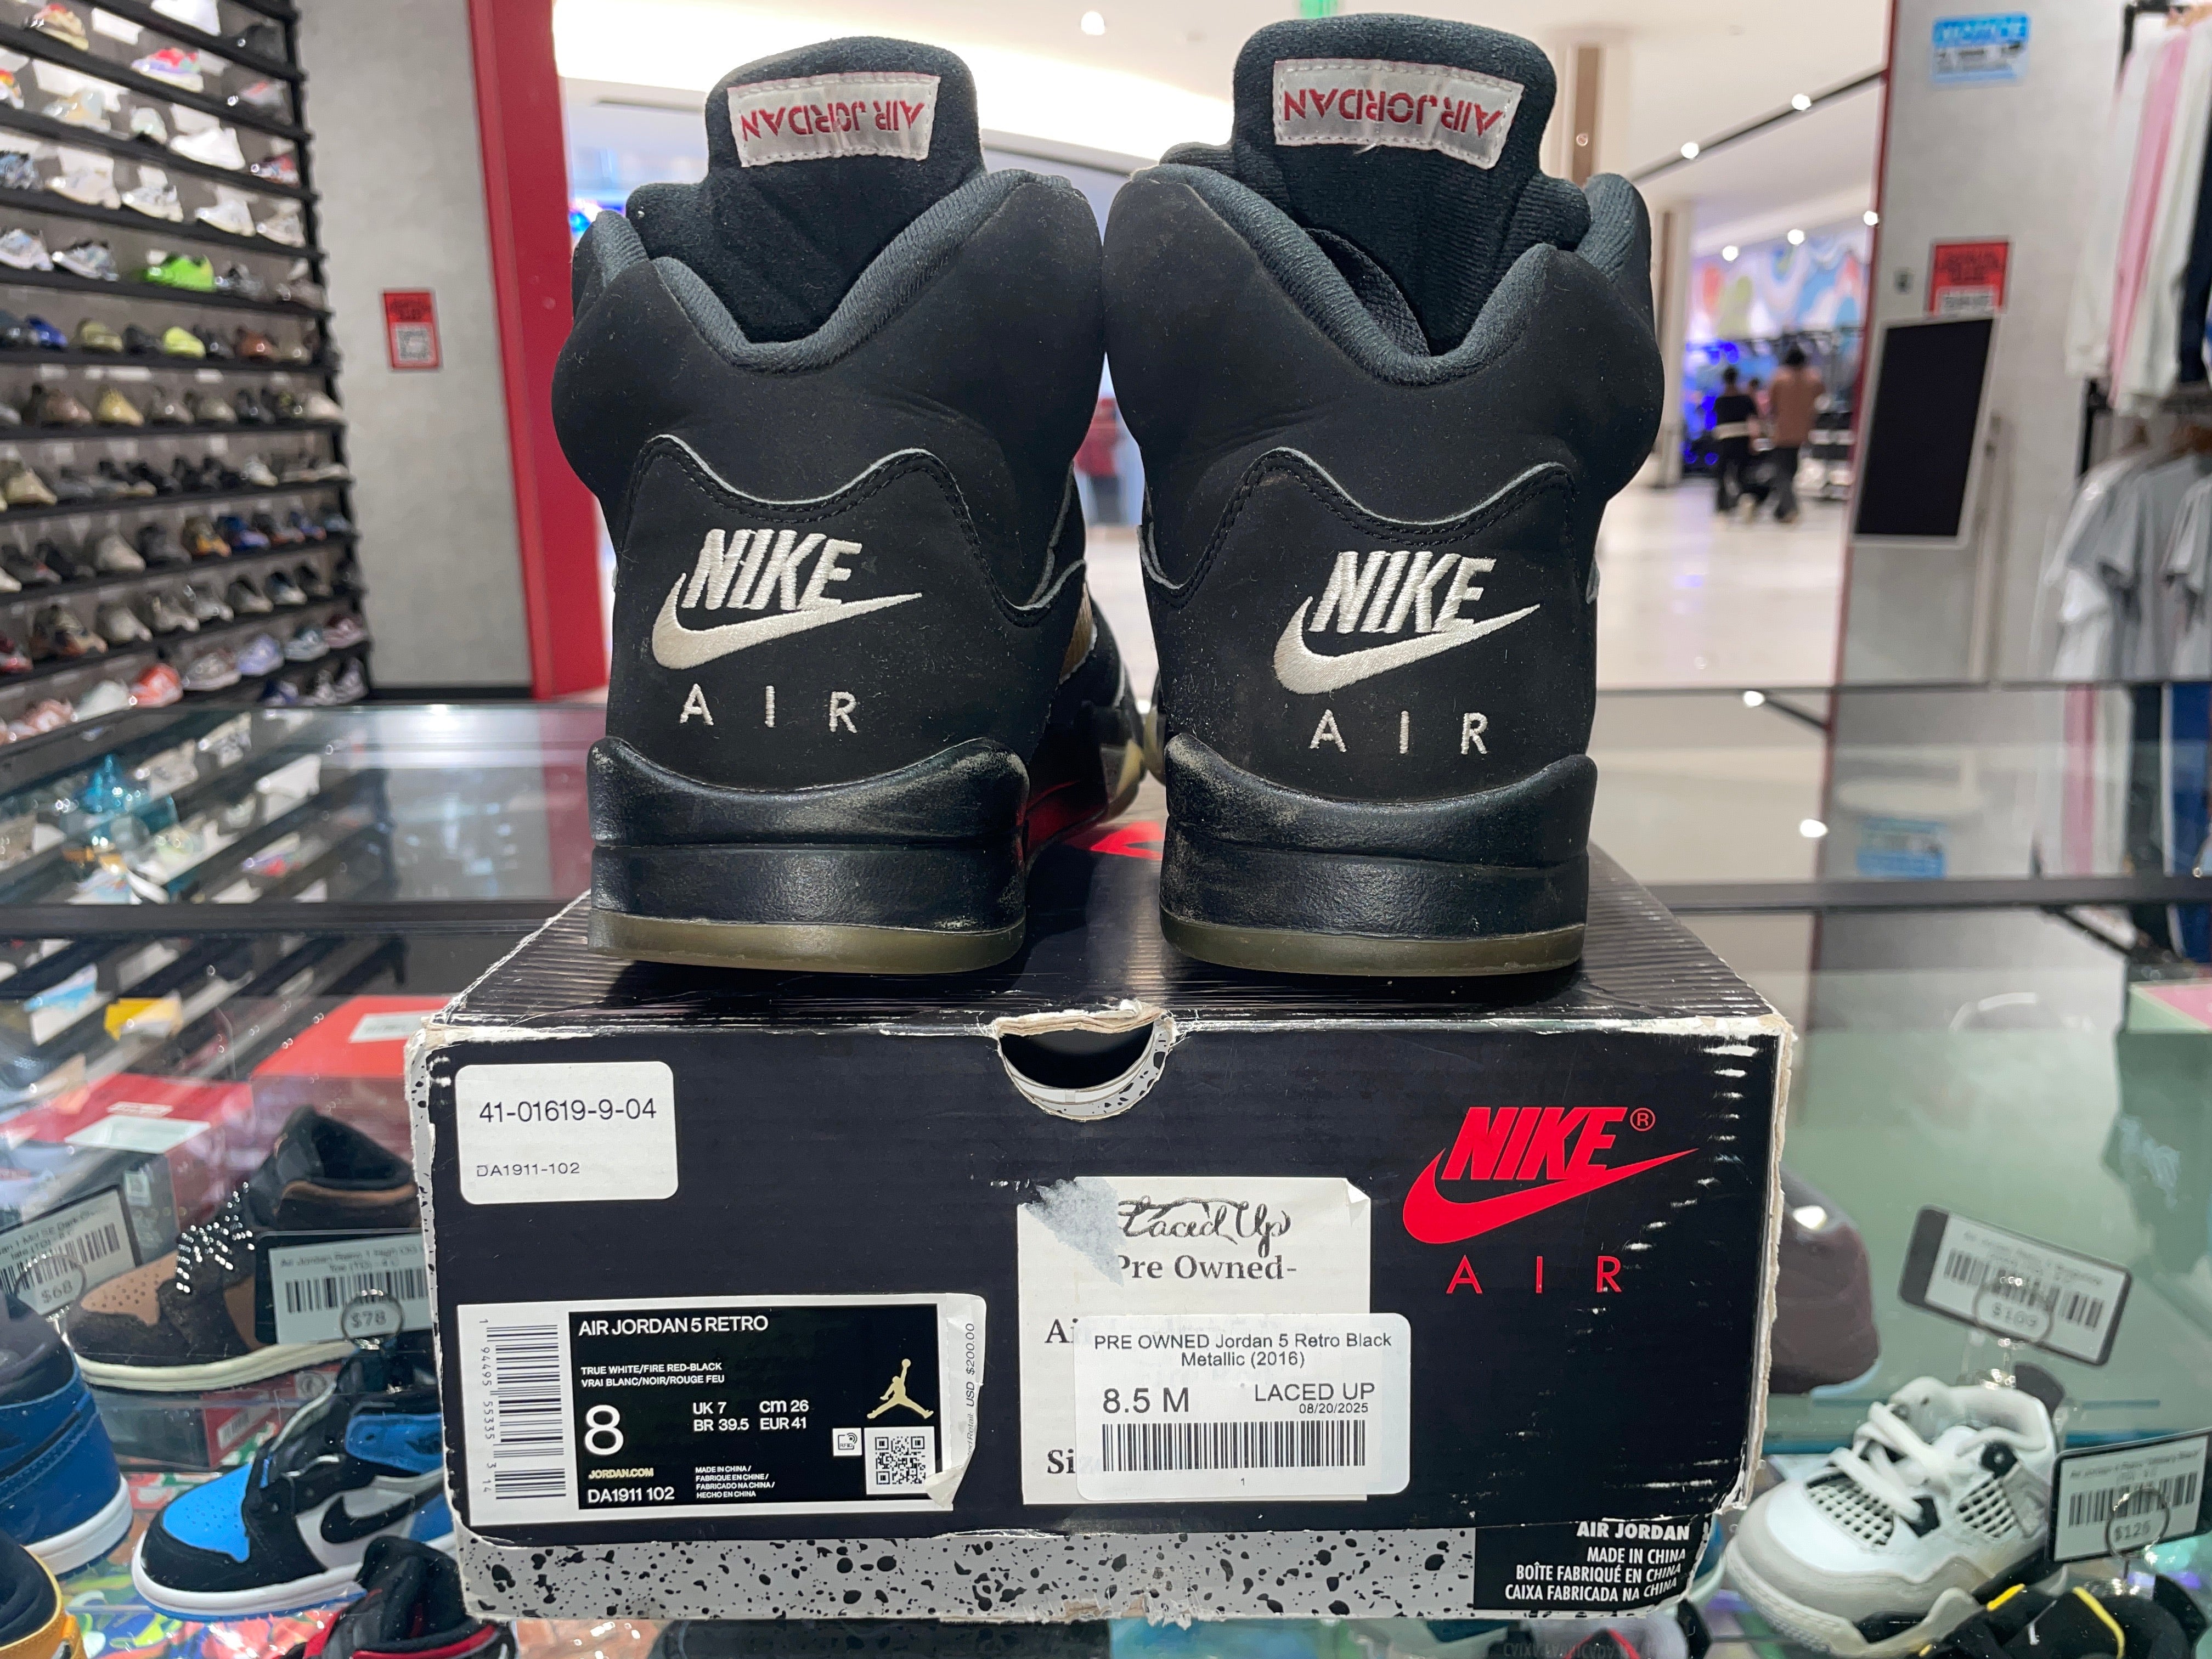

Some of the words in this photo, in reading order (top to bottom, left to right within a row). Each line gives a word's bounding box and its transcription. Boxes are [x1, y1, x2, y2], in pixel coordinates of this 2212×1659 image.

[873, 100, 925, 131] AIR
[1284, 88, 1438, 125] JORDAN
[1440, 97, 1503, 137] AIR
[741, 101, 866, 141] JORDAN
[681, 528, 862, 610] NIKE
[1308, 550, 1497, 634] NIKE
[680, 684, 857, 733] AIR
[1310, 709, 1488, 754] AIR
[479, 1098, 657, 1122] 41-01619-9-04
[1441, 1107, 1628, 1180] NIKE
[477, 1163, 580, 1177] DA1911-102
[1175, 1255, 1296, 1279] Owned-
[1446, 1254, 1622, 1294] AIR
[579, 1320, 609, 1336] AIR
[611, 1317, 688, 1335] JORDAN
[691, 1317, 702, 1333] 5
[705, 1315, 769, 1332] RETRO
[966, 1323, 975, 1375] $200.00
[1094, 1335, 1132, 1350] PRE
[1138, 1334, 1209, 1349] OWNED
[1215, 1334, 1272, 1348] Jordan
[1279, 1333, 1288, 1347] 5
[1295, 1333, 1340, 1347] Retro
[1346, 1333, 1391, 1346] Black
[580, 1366, 607, 1375] TRUE
[608, 1364, 665, 1374] WHITE/FIRE
[667, 1362, 723, 1372] RED-BLACK
[1181, 1352, 1245, 1366] Metallic
[1251, 1351, 1305, 1369] (2016)
[581, 1379, 603, 1387] VRAI
[606, 1375, 704, 1387] BLANC/NOIR/ROUGE
[706, 1375, 725, 1383] FEU
[966, 1381, 975, 1407] USD
[1103, 1387, 1150, 1413] 8.5
[1163, 1387, 1189, 1412] M
[1255, 1383, 1334, 1401] LACED
[1343, 1383, 1375, 1400] UP
[693, 1402, 714, 1415] UK
[718, 1402, 727, 1414] 7
[790, 1400, 809, 1413] 26
[1299, 1403, 1368, 1414] 08/20/2025
[584, 1404, 624, 1456] 8
[693, 1419, 714, 1432] BR
[718, 1418, 749, 1431] 39.5
[760, 1417, 789, 1431] EUR
[791, 1417, 806, 1429] 41
[588, 1468, 654, 1480] JORDAN.COM
[587, 1487, 642, 1504] DA1911
[646, 1486, 675, 1500] 102
[1576, 1521, 1609, 1538] AIR
[1615, 1523, 1690, 1541] JORDAN
[1587, 1547, 1625, 1563] MADE
[1629, 1548, 1643, 1564] IN
[1647, 1548, 1686, 1564] CHINA
[1516, 1561, 1553, 1581] BOÎTE
[1557, 1564, 1621, 1583] FABRIQUÉ
[1626, 1568, 1641, 1583] EN
[1646, 1563, 1681, 1582] CHINA
[1505, 1584, 1543, 1600] CAIXA
[1547, 1587, 1618, 1601] FABRICADA
[1623, 1588, 1640, 1601] NA
[1644, 1577, 1677, 1598] CHINA
